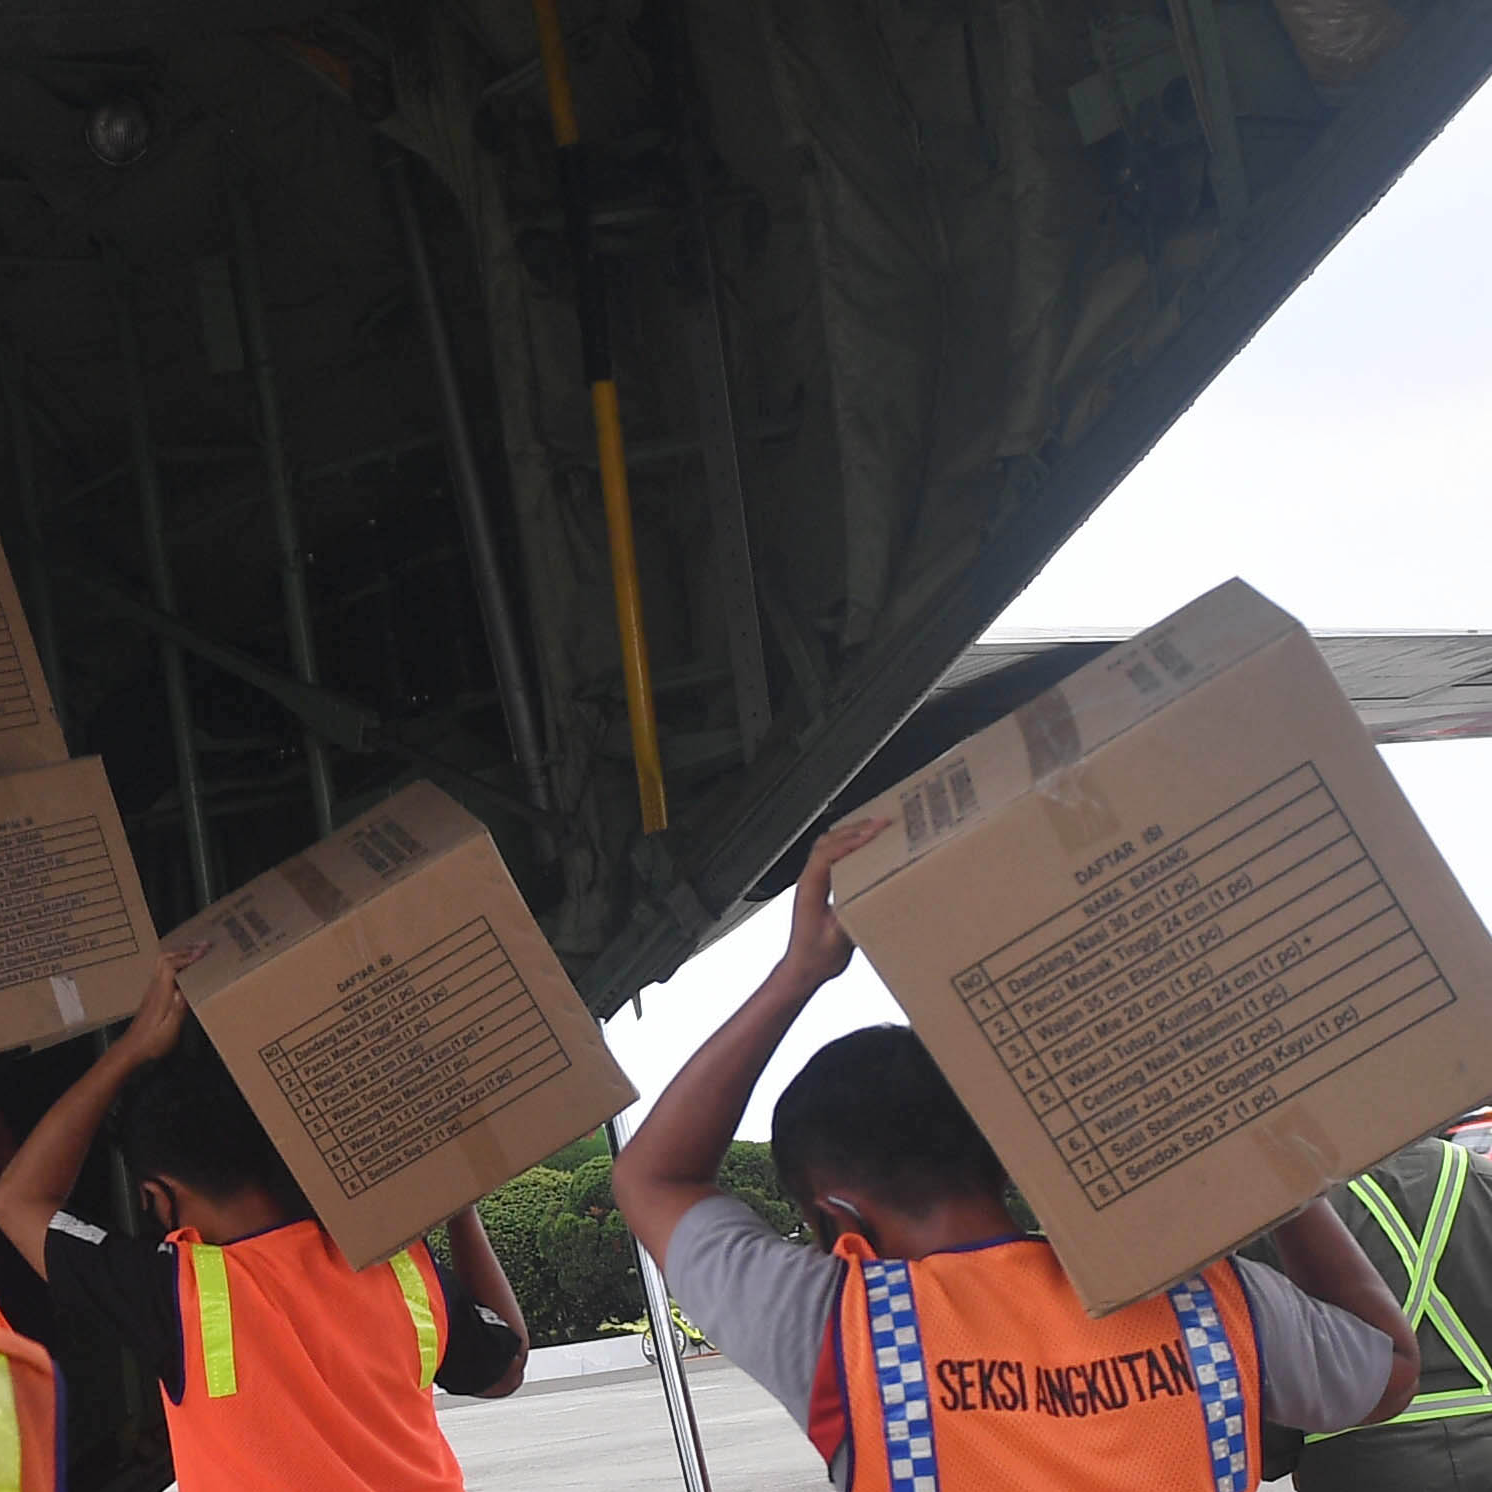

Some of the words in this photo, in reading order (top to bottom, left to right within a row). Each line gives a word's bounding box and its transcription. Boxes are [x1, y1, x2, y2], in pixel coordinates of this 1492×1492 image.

[1075, 842, 1135, 885] DAFTAR
[1142, 825, 1163, 844] ISI
[960, 973, 983, 991] NO
[1083, 888, 1123, 917] NAMA
[1130, 848, 1188, 889] BARANG
[1007, 950, 1076, 994] Dandang
[1073, 926, 1109, 954] Nasi
[1109, 913, 1129, 933] 30
[1131, 901, 1155, 921] cm
[1155, 888, 1172, 910] (1
[1173, 872, 1200, 900] pc)
[1022, 984, 1065, 1018] Panci
[1065, 959, 1114, 991] Masak
[1114, 928, 1162, 960] Tinggi
[1162, 914, 1182, 934] 24
[1184, 901, 1208, 921] cm
[1208, 889, 1225, 910] (1
[1226, 873, 1253, 901] pc)
[1036, 1010, 1083, 1041] Wajan
[1083, 994, 1104, 1013] 35
[1105, 982, 1129, 1001] cm
[1179, 938, 1200, 961] (1
[1197, 923, 1224, 951] pc)
[1051, 1032, 1095, 1065] Panci
[1094, 1018, 1122, 1038] Mie
[1123, 1002, 1144, 1022] 20
[1145, 990, 1169, 1009] cm
[1169, 977, 1185, 997] (1
[1187, 961, 1214, 988] pc)
[1112, 1030, 1156, 1059] Tutup
[1156, 998, 1213, 1035] Kuning
[1211, 982, 1232, 1002] 24
[1234, 970, 1258, 989] cm
[1257, 956, 1275, 980] (1
[1276, 941, 1303, 969] pc)
[1082, 1070, 1146, 1111] Centong
[1144, 1047, 1180, 1073] Nasi
[1179, 1012, 1242, 1052] Melamin
[1243, 998, 1261, 1019] (1
[1261, 983, 1288, 1010] pc)
[1095, 1104, 1139, 1134] Water
[1143, 1086, 1172, 1109] Jug
[1171, 1068, 1195, 1089] 1.5
[1194, 1050, 1229, 1076] Liter
[1231, 1037, 1249, 1058] (2
[1249, 1017, 1284, 1049] pcs)
[1146, 1093, 1214, 1136] Stainless
[1215, 1057, 1275, 1095] Gagang
[1273, 1034, 1314, 1062] Kayu
[1315, 1020, 1331, 1042] (1
[1333, 1005, 1360, 1032] pc)
[1125, 1143, 1182, 1181] Sendok
[1182, 1125, 1214, 1147] Sop
[1233, 1100, 1252, 1123] (1
[1251, 1085, 1279, 1112] pc)
[935, 1358, 1029, 1412] SEKSI
[1035, 1339, 1197, 1418] ANGKUTAN
